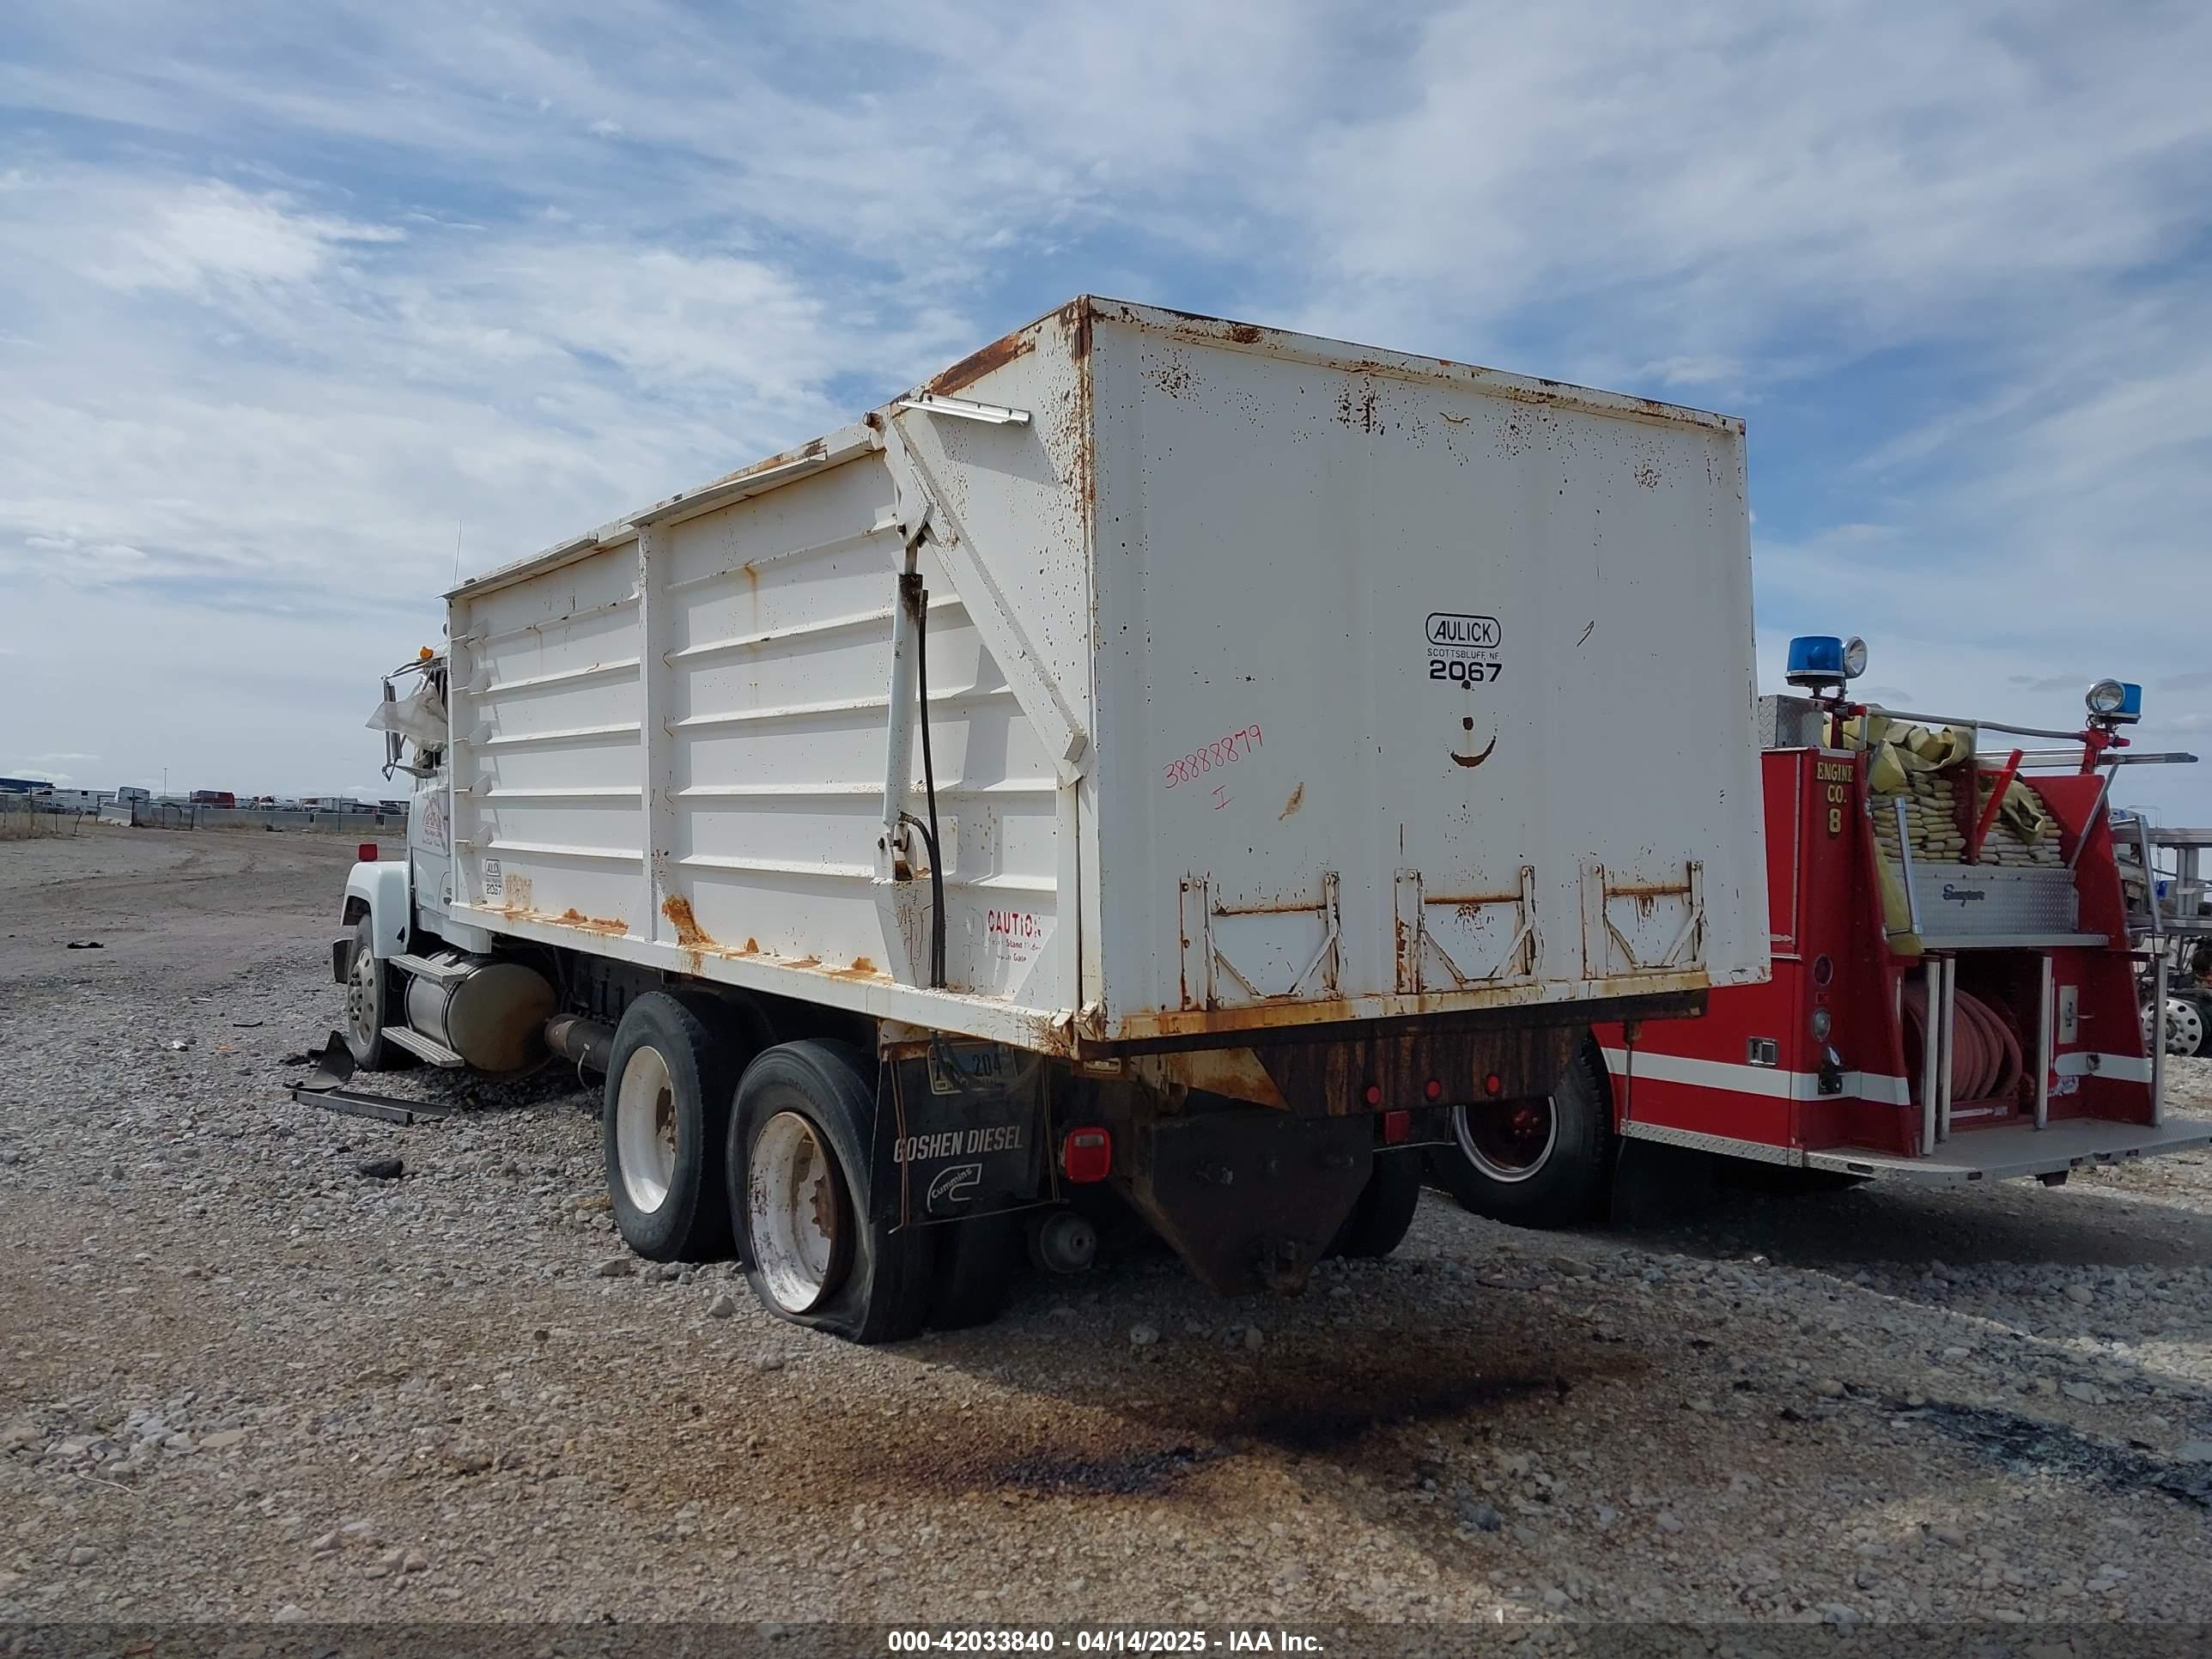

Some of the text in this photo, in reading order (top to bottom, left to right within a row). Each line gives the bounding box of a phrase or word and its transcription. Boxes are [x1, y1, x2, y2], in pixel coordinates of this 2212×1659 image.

[1433, 620, 1492, 642] AULICK
[1427, 647, 1486, 660] SCOTTSBLUFF,
[1429, 659, 1503, 682] 2067
[1163, 724, 1262, 788] 38888879
[1816, 762, 1854, 782] ENGINE
[1827, 785, 1847, 803] CO.
[1829, 808, 1842, 833] 8
[893, 1125, 1024, 1164] GOSHEN DIESEL
